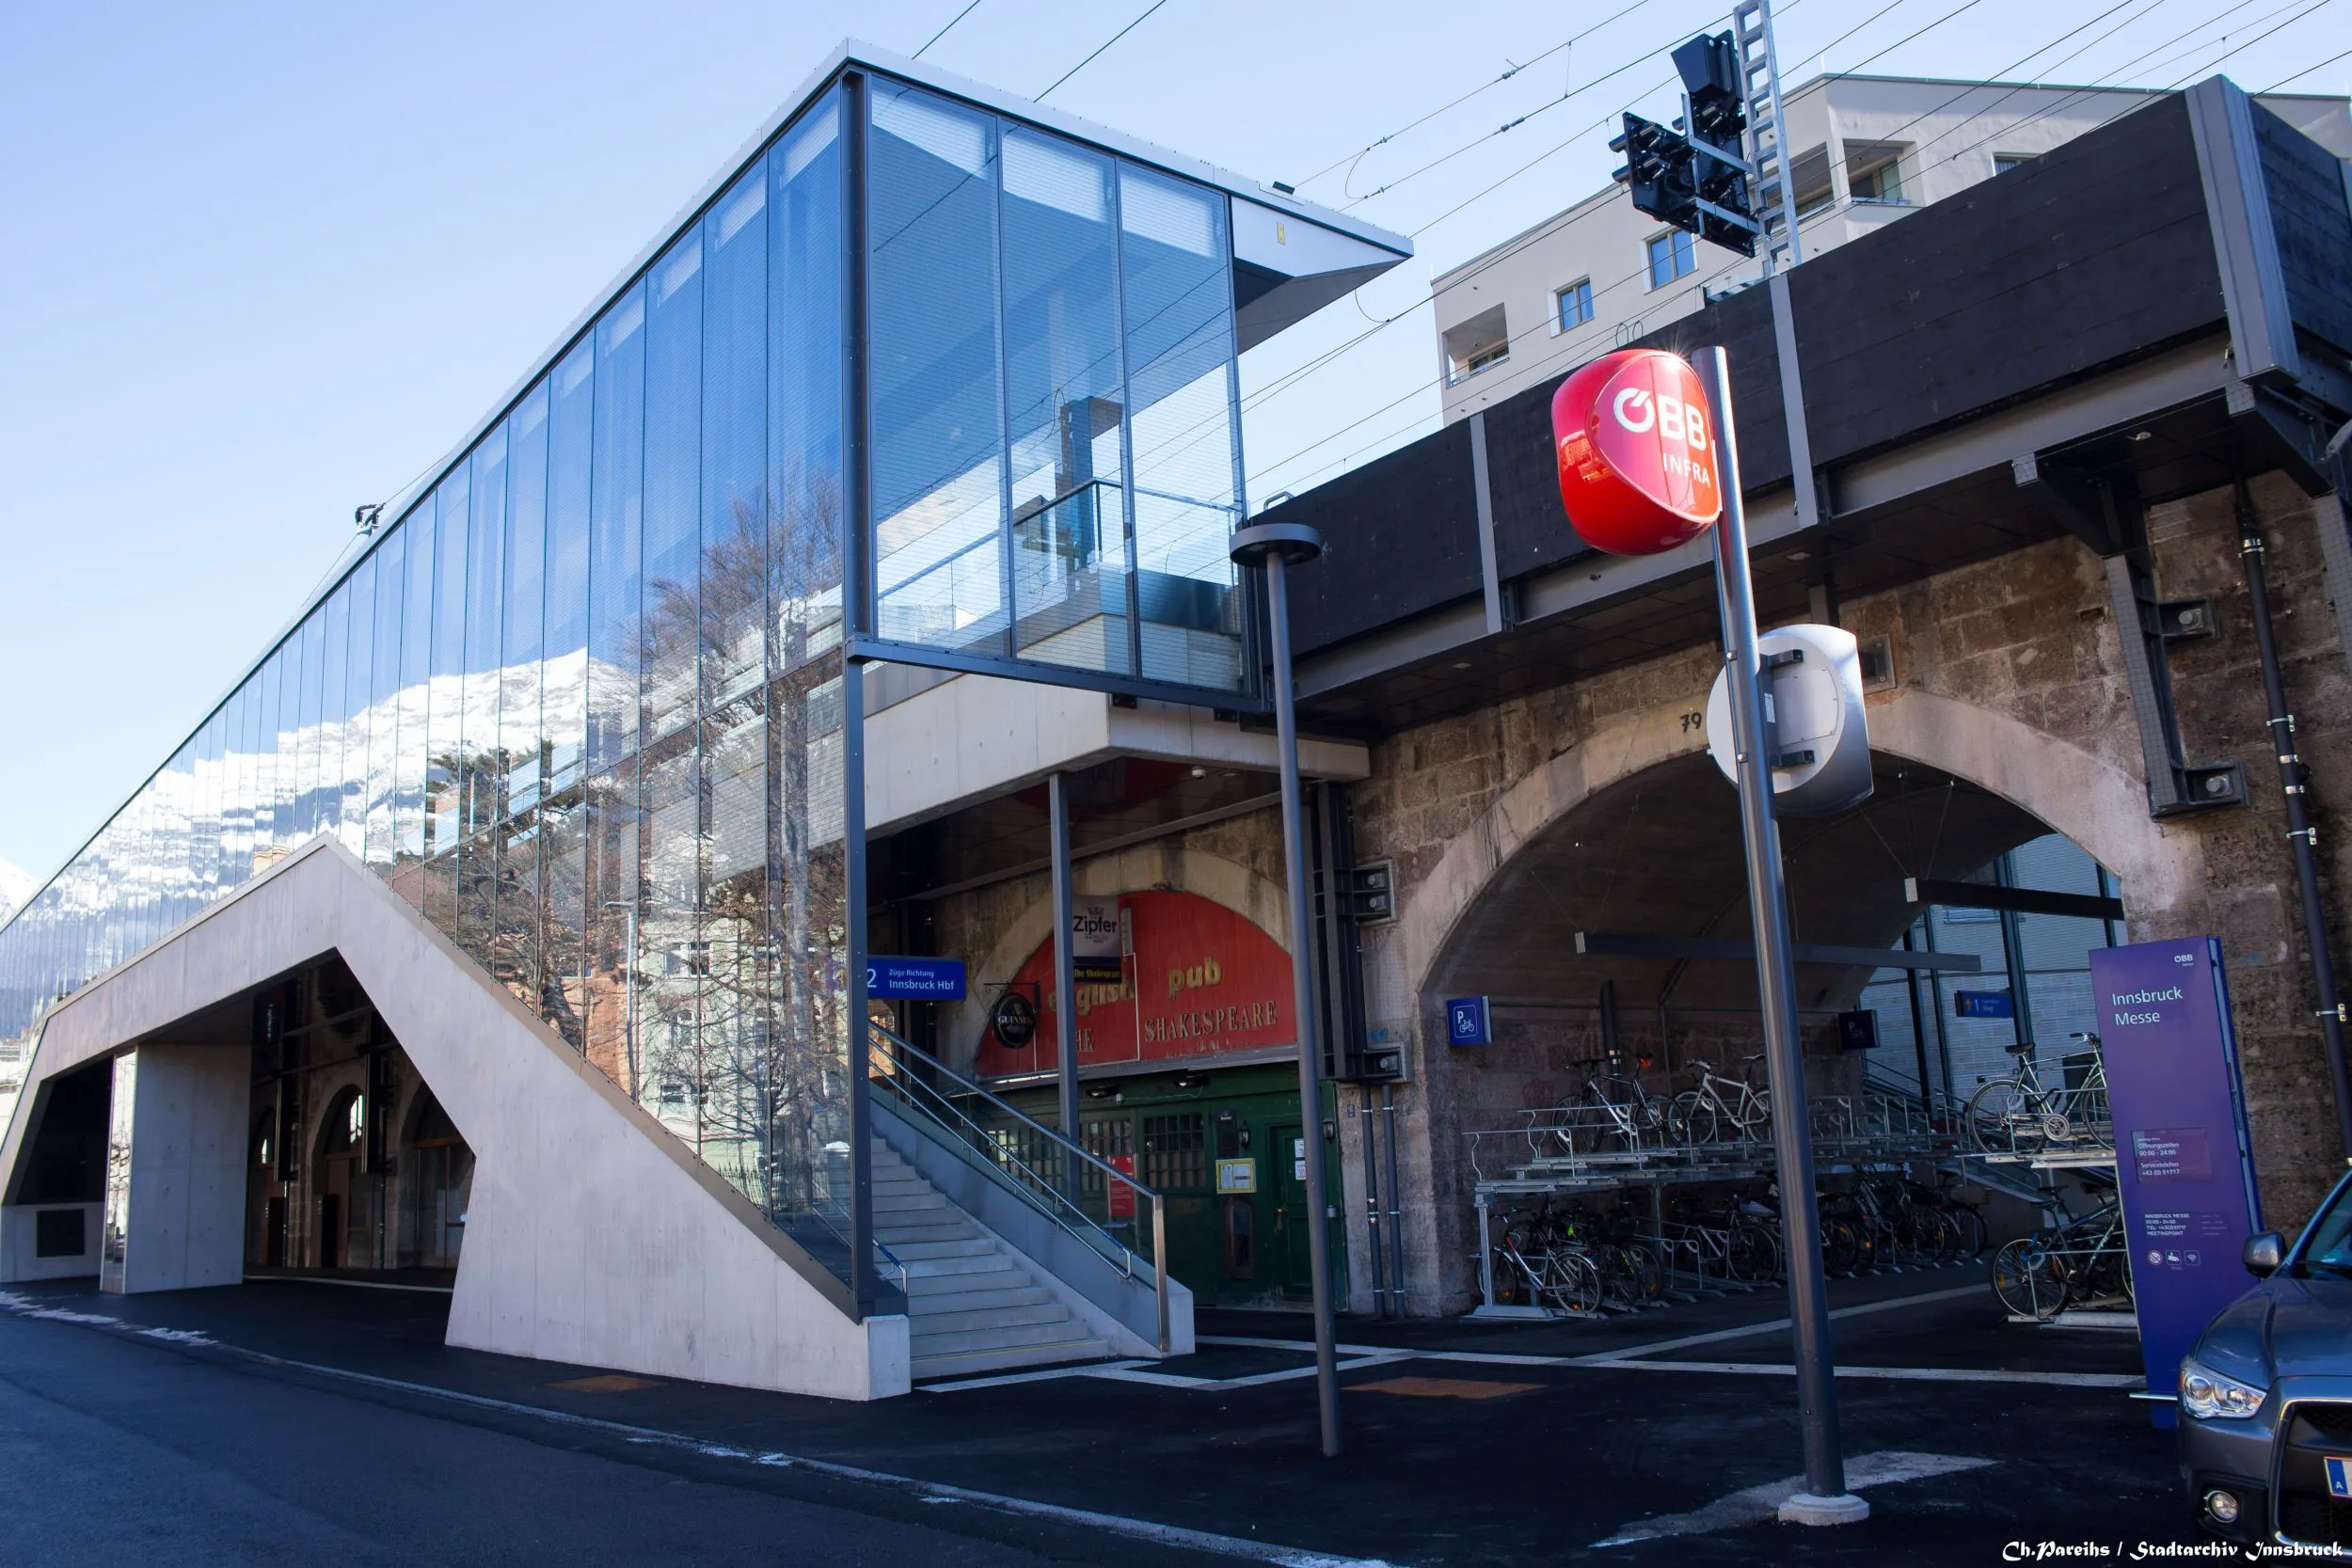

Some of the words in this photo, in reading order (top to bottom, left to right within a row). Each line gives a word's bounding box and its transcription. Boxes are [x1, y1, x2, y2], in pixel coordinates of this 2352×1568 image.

[1613, 387, 1708, 451] ÖBB
[1662, 452, 1711, 488] INFRA
[1679, 712, 1702, 733] 79
[1073, 916, 1117, 935] Zipfer
[2173, 953, 2193, 963] ÖBB
[866, 968, 878, 989] 2
[889, 968, 906, 978] Züge
[906, 969, 934, 979] Richtung
[889, 979, 935, 990] Innsbruck
[937, 980, 955, 990] Hbf
[1047, 971, 1135, 1017] eglish
[1168, 956, 1222, 1001] pub
[2111, 986, 2184, 1006] Innsbruck
[997, 1015, 1033, 1024] GUINNE
[1456, 1010, 1465, 1024] P
[2114, 1011, 2161, 1026] Messe
[1075, 1028, 1094, 1053] HE
[1144, 1000, 1278, 1043] SHAKESPEARE
[1848, 1021, 1856, 1033] P
[2335, 1481, 2344, 1490] A
